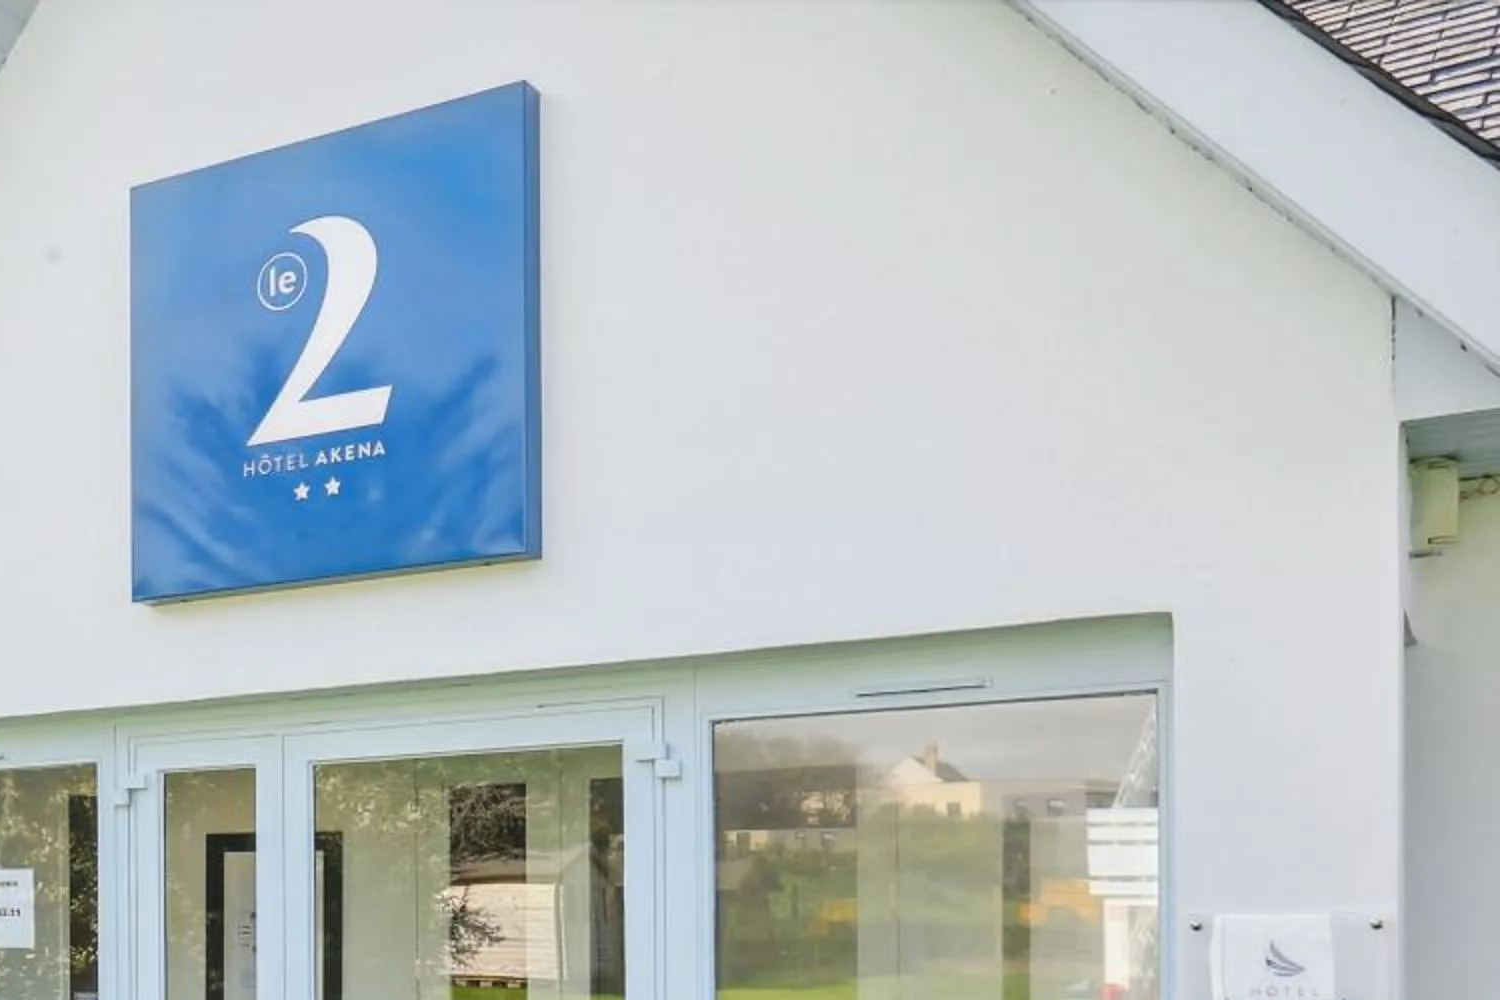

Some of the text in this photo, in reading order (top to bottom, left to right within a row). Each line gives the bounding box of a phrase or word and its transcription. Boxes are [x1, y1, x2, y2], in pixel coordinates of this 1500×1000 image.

[246, 215, 392, 447] le 2
[243, 441, 386, 477] HÔTEL AKENA
